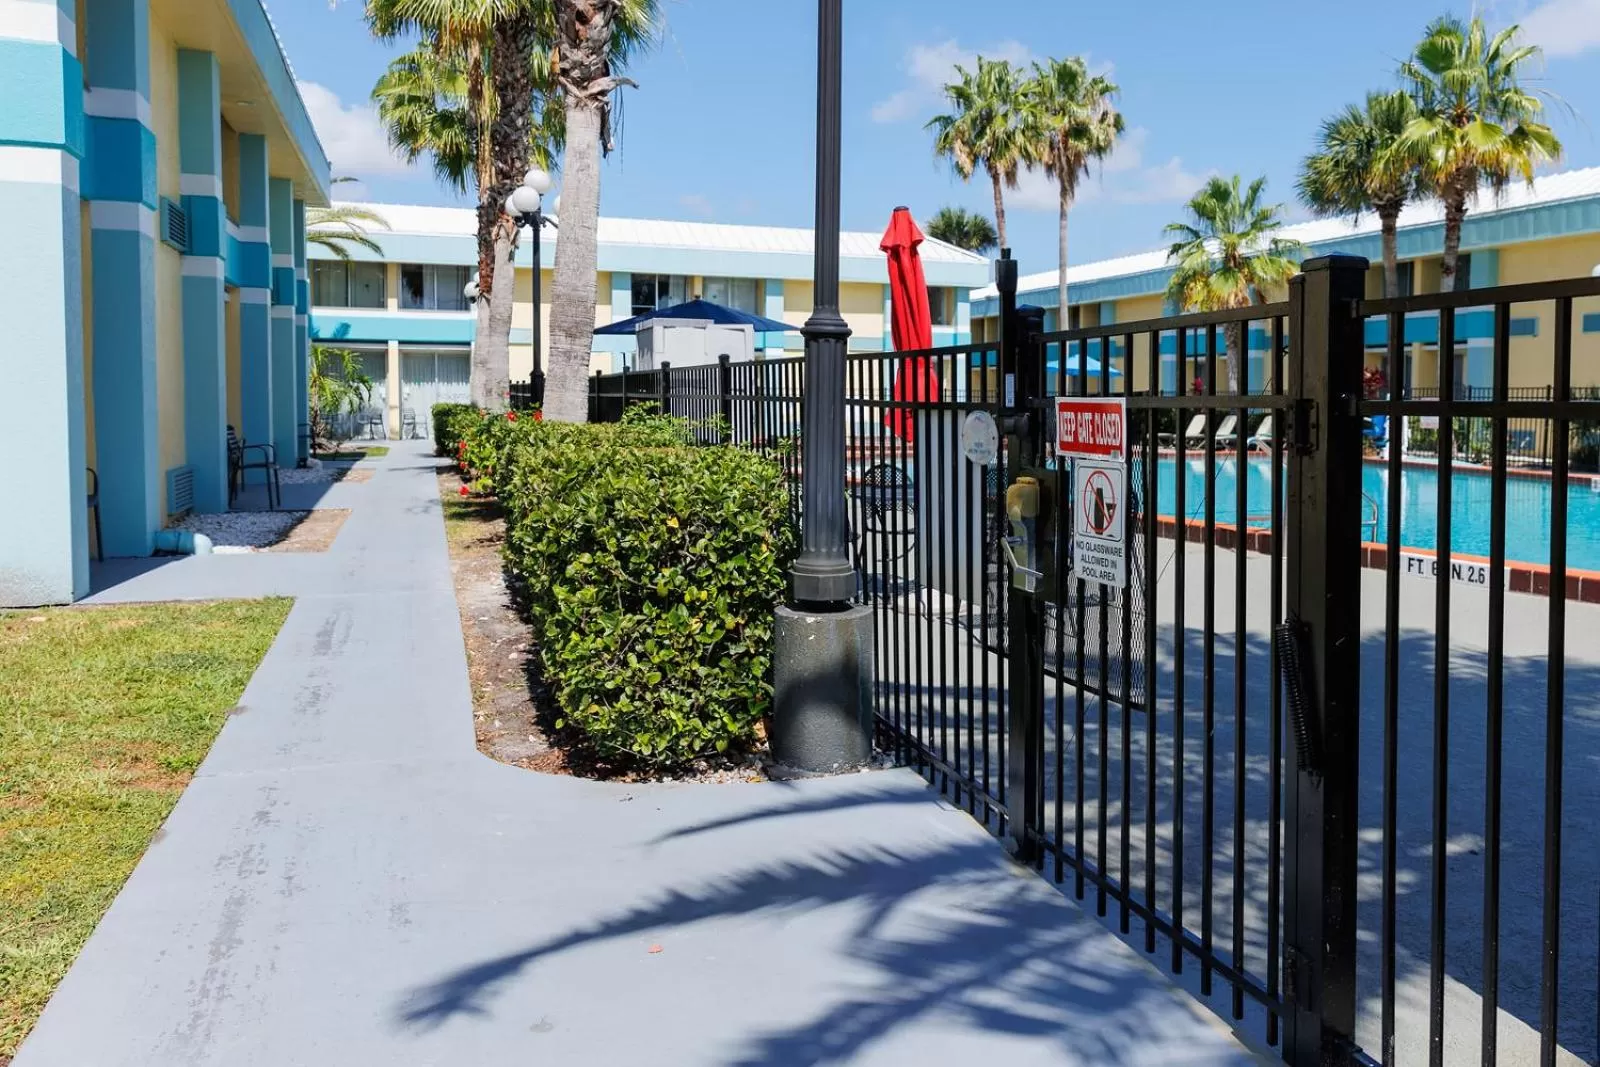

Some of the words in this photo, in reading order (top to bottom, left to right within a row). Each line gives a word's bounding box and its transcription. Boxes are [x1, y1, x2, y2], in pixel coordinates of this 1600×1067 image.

[1060, 411, 1075, 442] KEEP
[1077, 412, 1094, 444] GATE
[1095, 412, 1121, 446] CLOSED
[1076, 540, 1084, 550] NO
[1085, 541, 1123, 558] GLASSWARE
[1081, 553, 1110, 568] ALLOWED
[1110, 559, 1117, 569] IN
[1082, 566, 1098, 578] POOL
[1099, 570, 1116, 581] AREA
[1407, 557, 1424, 575] FT.
[1467, 565, 1486, 584] 2.6
